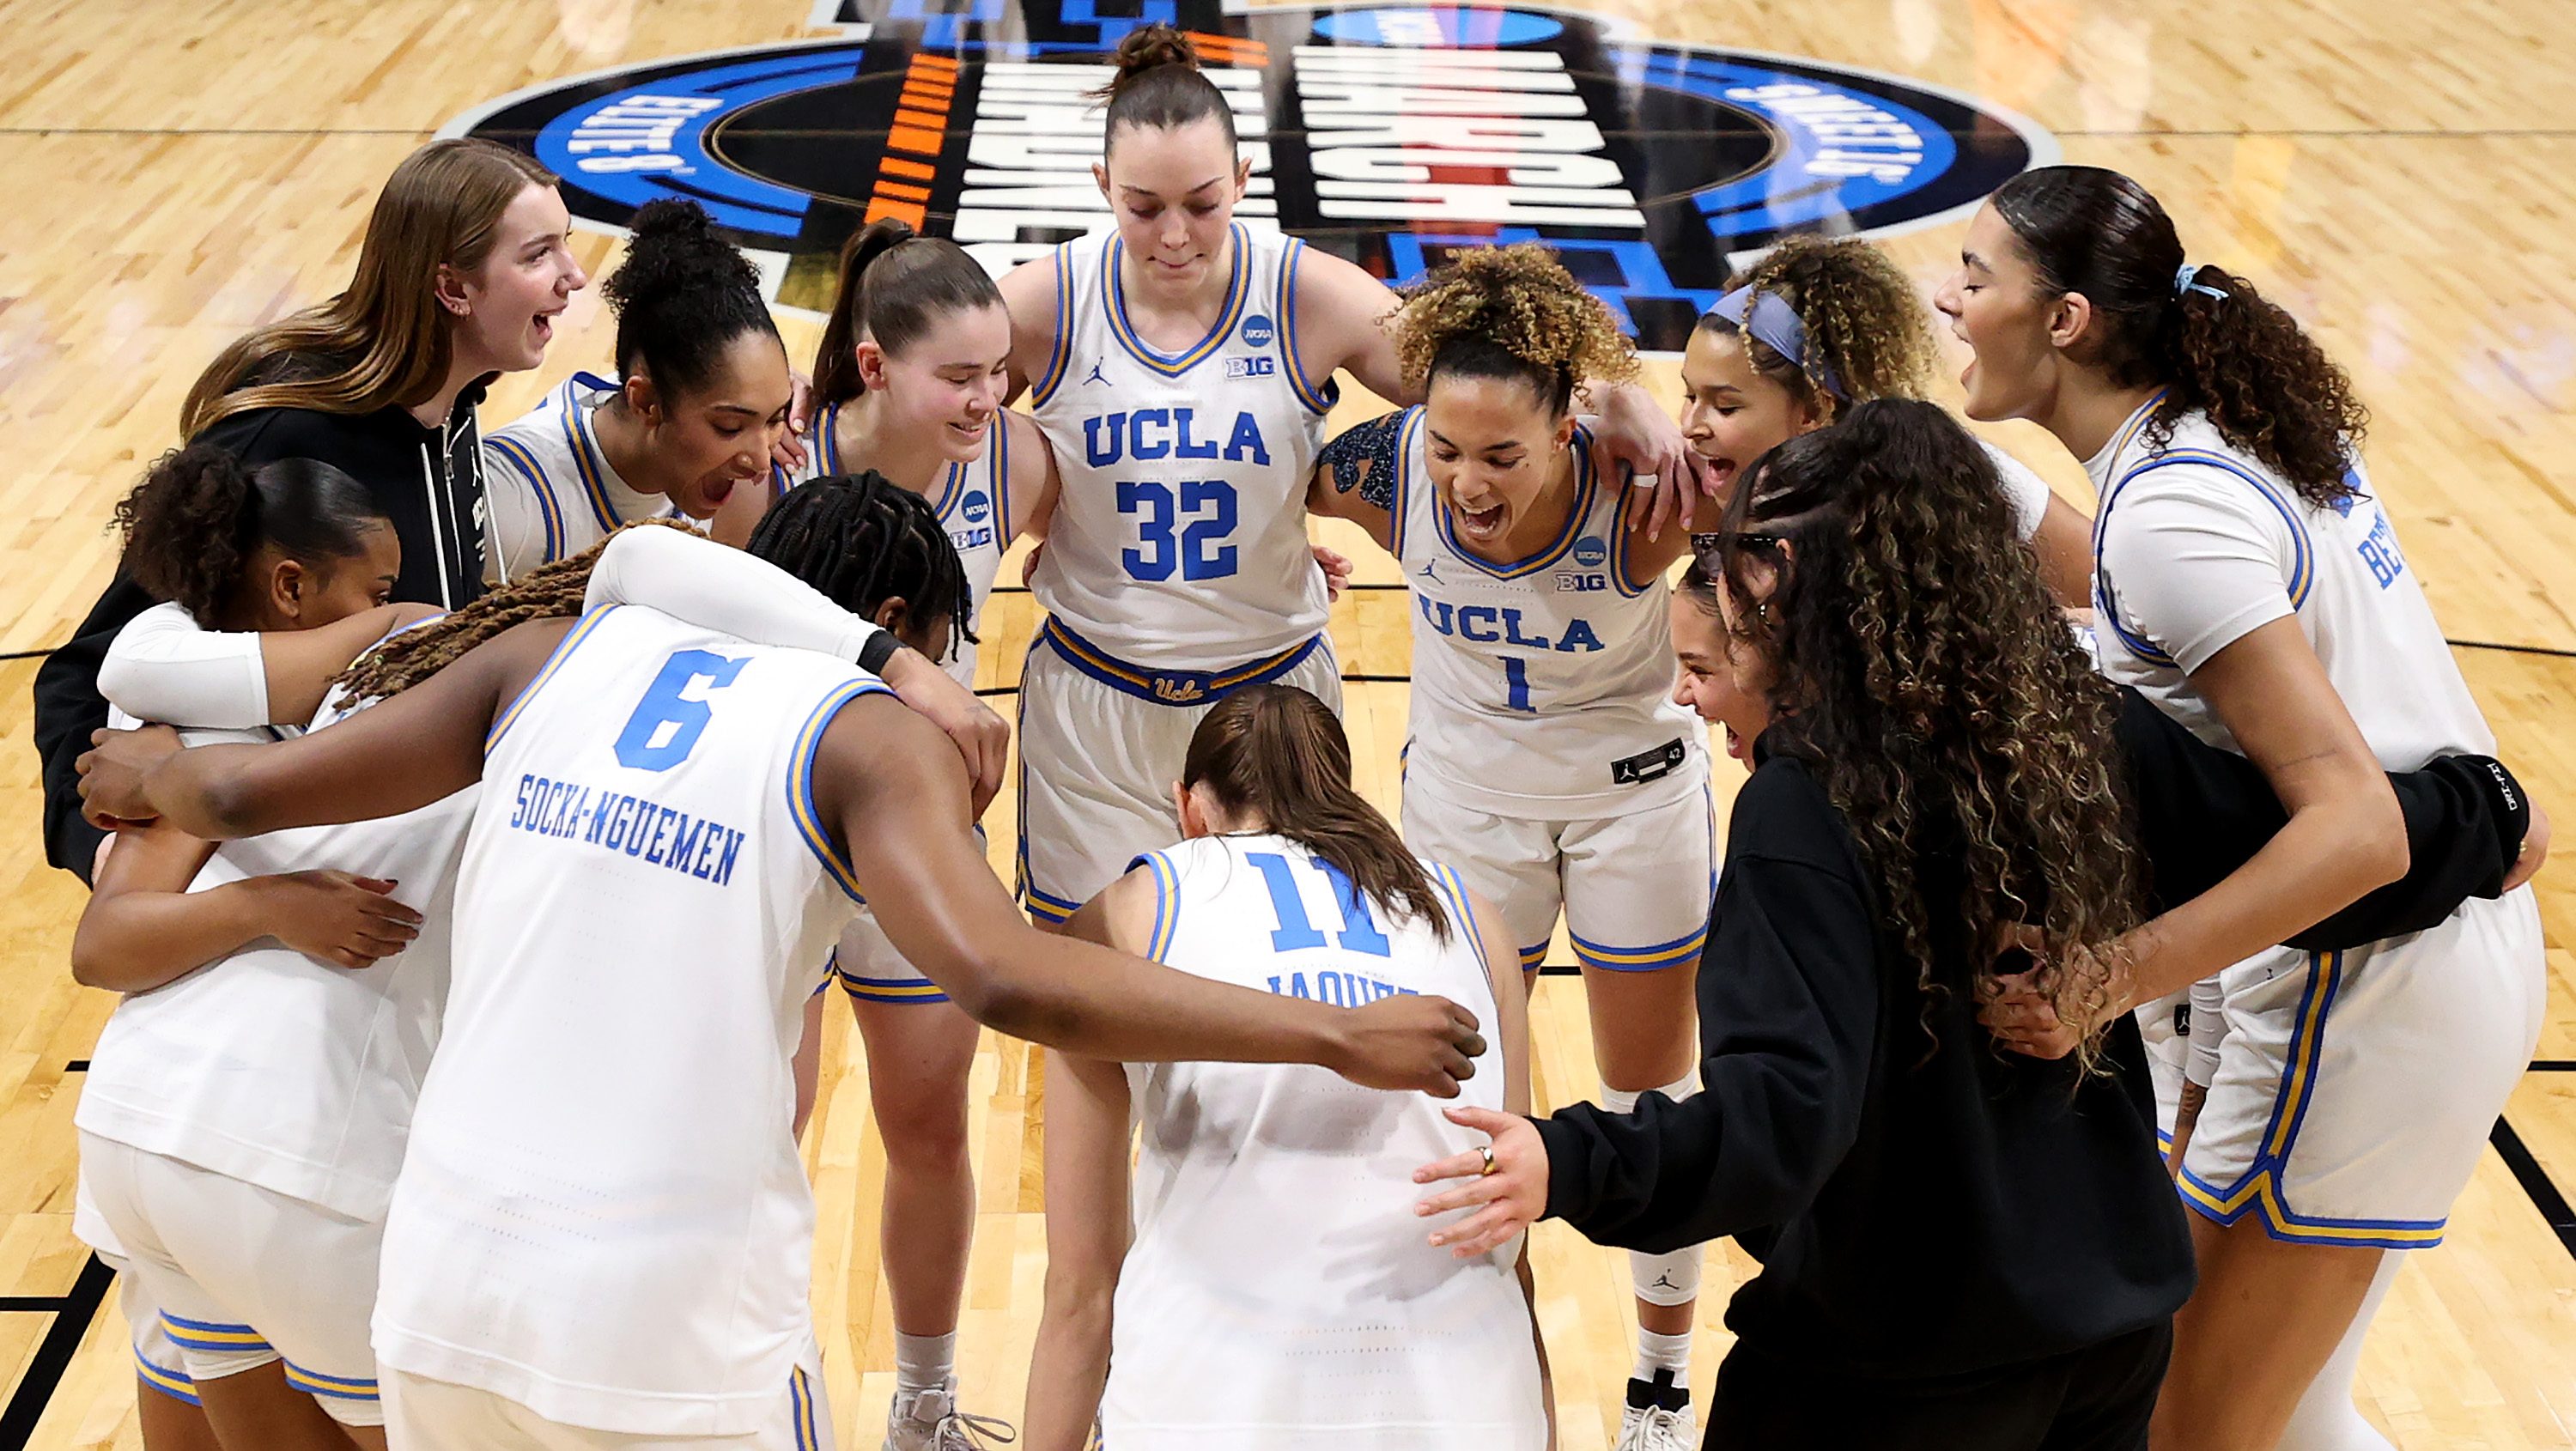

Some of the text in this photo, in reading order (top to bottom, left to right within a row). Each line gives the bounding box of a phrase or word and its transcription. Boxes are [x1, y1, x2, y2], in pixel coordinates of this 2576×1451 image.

[568, 94, 725, 173] ELITE 8
[951, 63, 1282, 282] MADNE
[1291, 46, 1647, 228] MARCH
[1724, 83, 1924, 179] SWEET 16
[1084, 407, 1271, 469] UCLA
[1116, 480, 1237, 581] 32
[1419, 593, 1605, 653] UCLA
[613, 649, 754, 773] 6
[1498, 656, 1537, 713] 1
[1668, 747, 1681, 760] 42
[511, 774, 747, 887] SOCKA-NGUEMEN
[1245, 852, 1391, 957] 11
